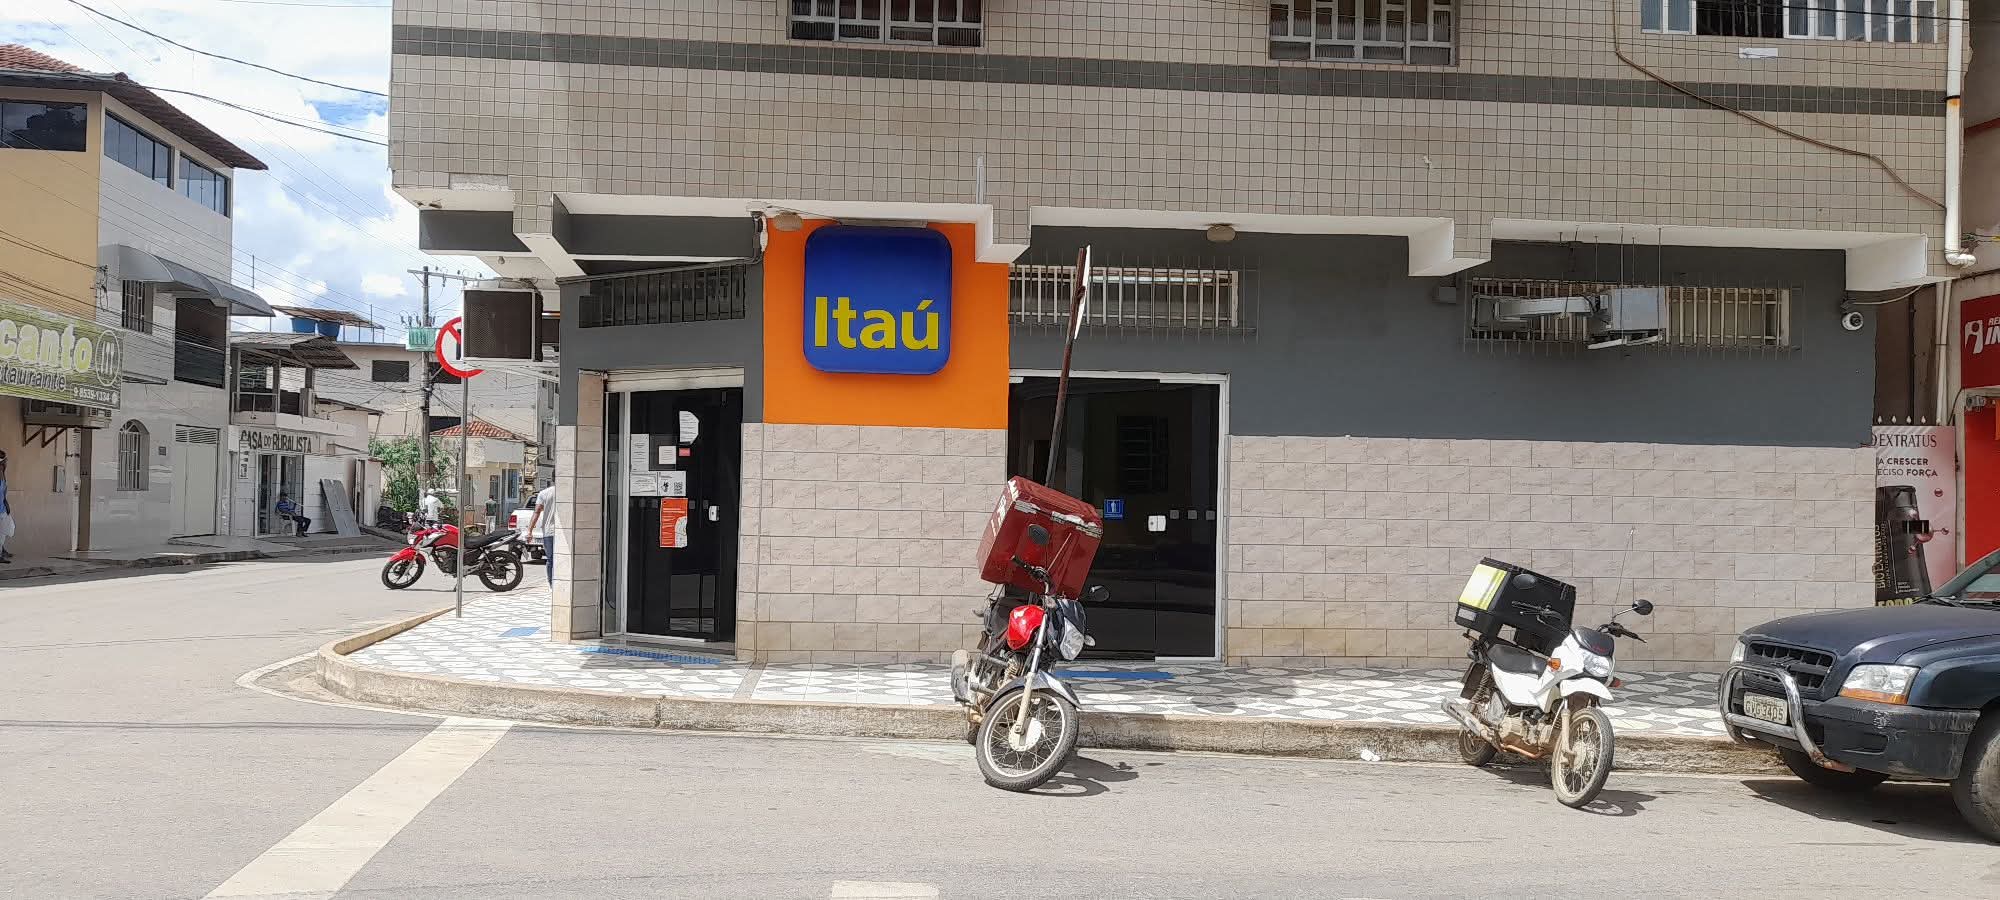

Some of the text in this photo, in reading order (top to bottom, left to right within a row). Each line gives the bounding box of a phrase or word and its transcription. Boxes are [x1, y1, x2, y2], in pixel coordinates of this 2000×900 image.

[813, 295, 941, 351] Itaú
[241, 430, 263, 449] CASA
[272, 433, 312, 453] RURALISTA
[1886, 457, 1929, 466] CRESCER
[1906, 469, 1938, 479] FORÇA
